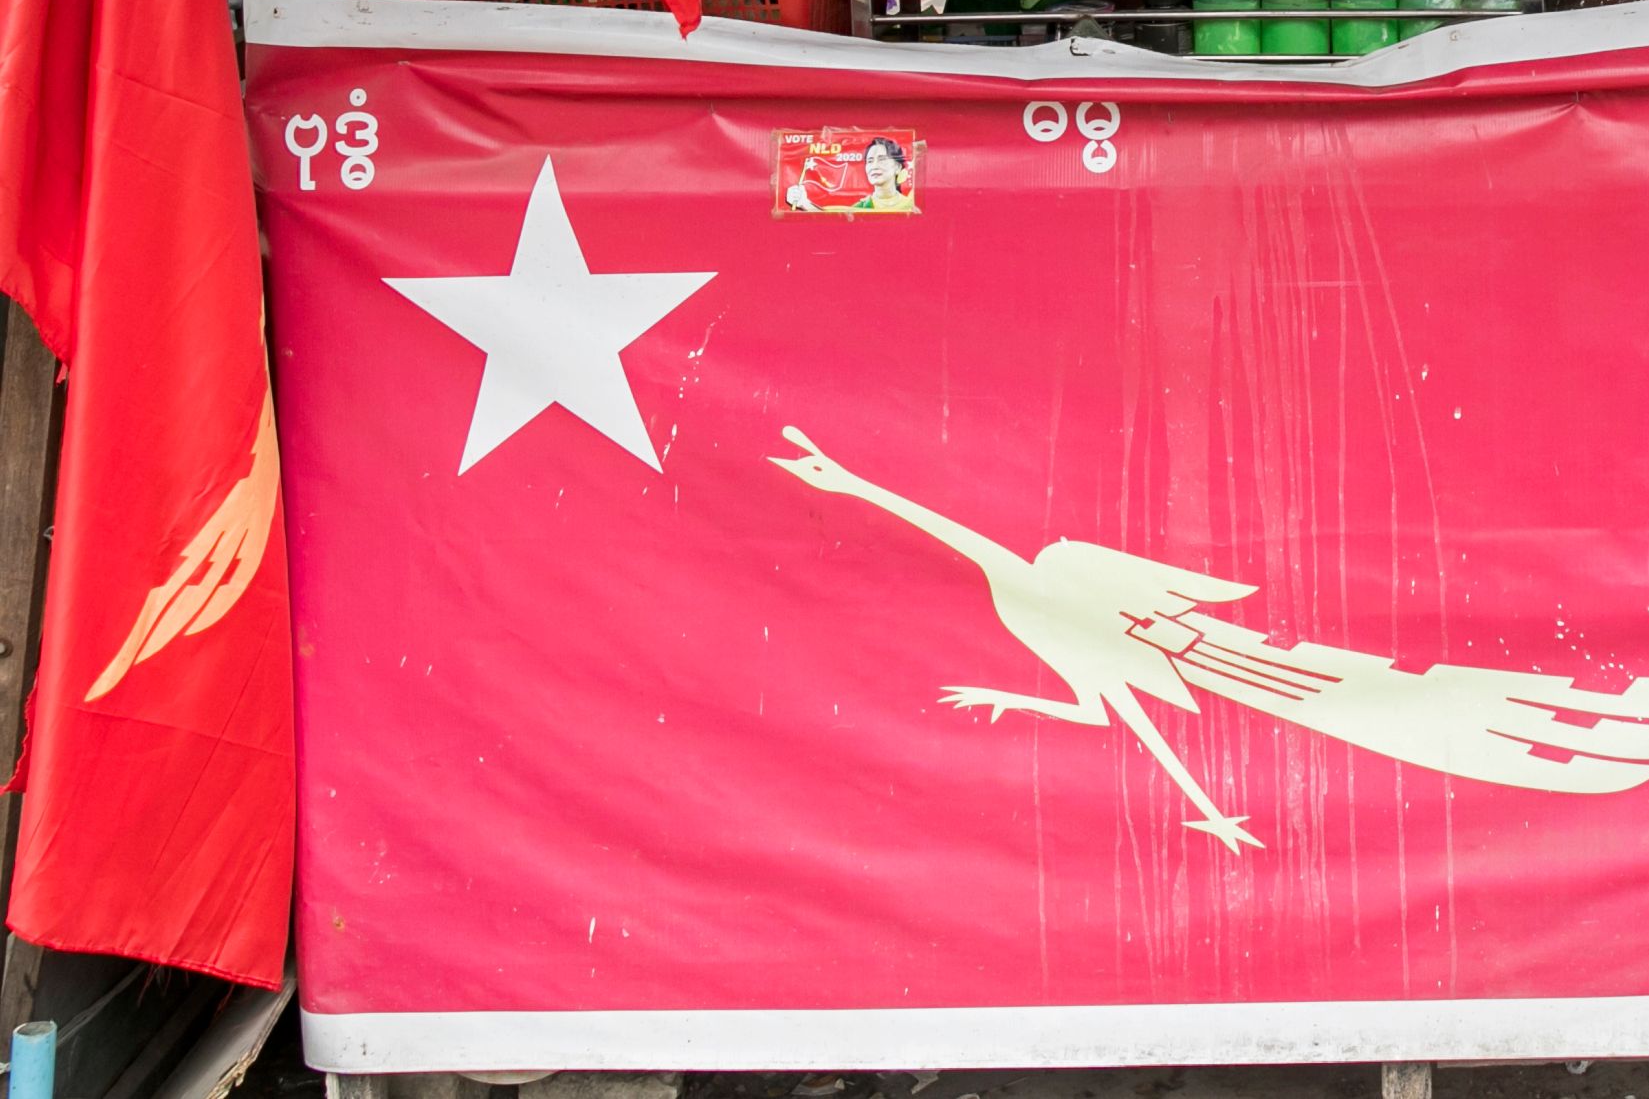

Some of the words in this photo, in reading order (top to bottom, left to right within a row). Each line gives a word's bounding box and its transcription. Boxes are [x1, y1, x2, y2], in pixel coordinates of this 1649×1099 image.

[785, 134, 814, 144] VOTE
[809, 143, 842, 155] NLD
[836, 152, 863, 162] 2020
